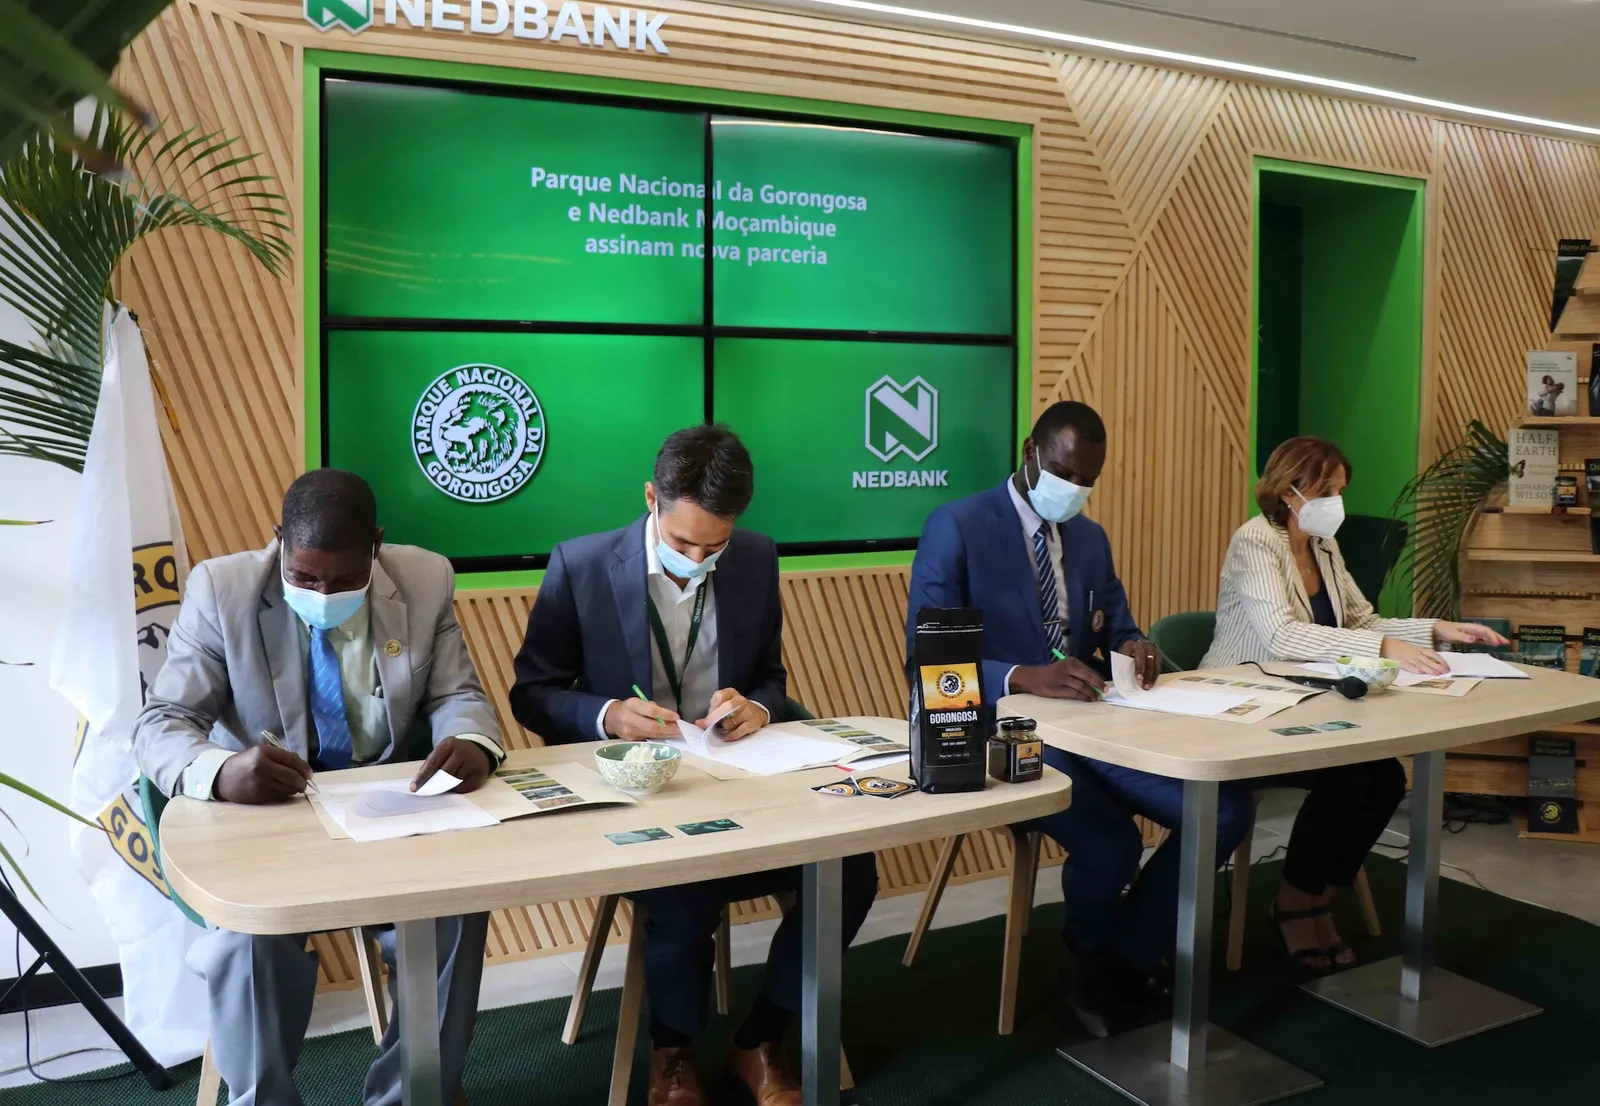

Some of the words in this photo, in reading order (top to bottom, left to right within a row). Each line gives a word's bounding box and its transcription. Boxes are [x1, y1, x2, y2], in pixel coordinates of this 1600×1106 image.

[384, 0, 670, 54] NEDBANK
[531, 167, 612, 196] Parque
[619, 173, 722, 200] Nacional
[728, 182, 753, 202] da
[760, 184, 867, 214] Gorongosa
[568, 207, 581, 222] e
[589, 202, 690, 228] Nedbank
[696, 209, 837, 240] Moçambique
[585, 235, 674, 257] assinam
[681, 239, 741, 260] nova
[747, 244, 828, 266] parceria
[416, 379, 453, 455] PARQUE
[456, 368, 537, 421] NACIONAL
[524, 427, 541, 453] DA
[1516, 446, 1556, 456] EARTH
[427, 459, 533, 499] GORONGOSA
[852, 470, 948, 488] NEDBANK
[930, 711, 978, 724] GORONGOSA
